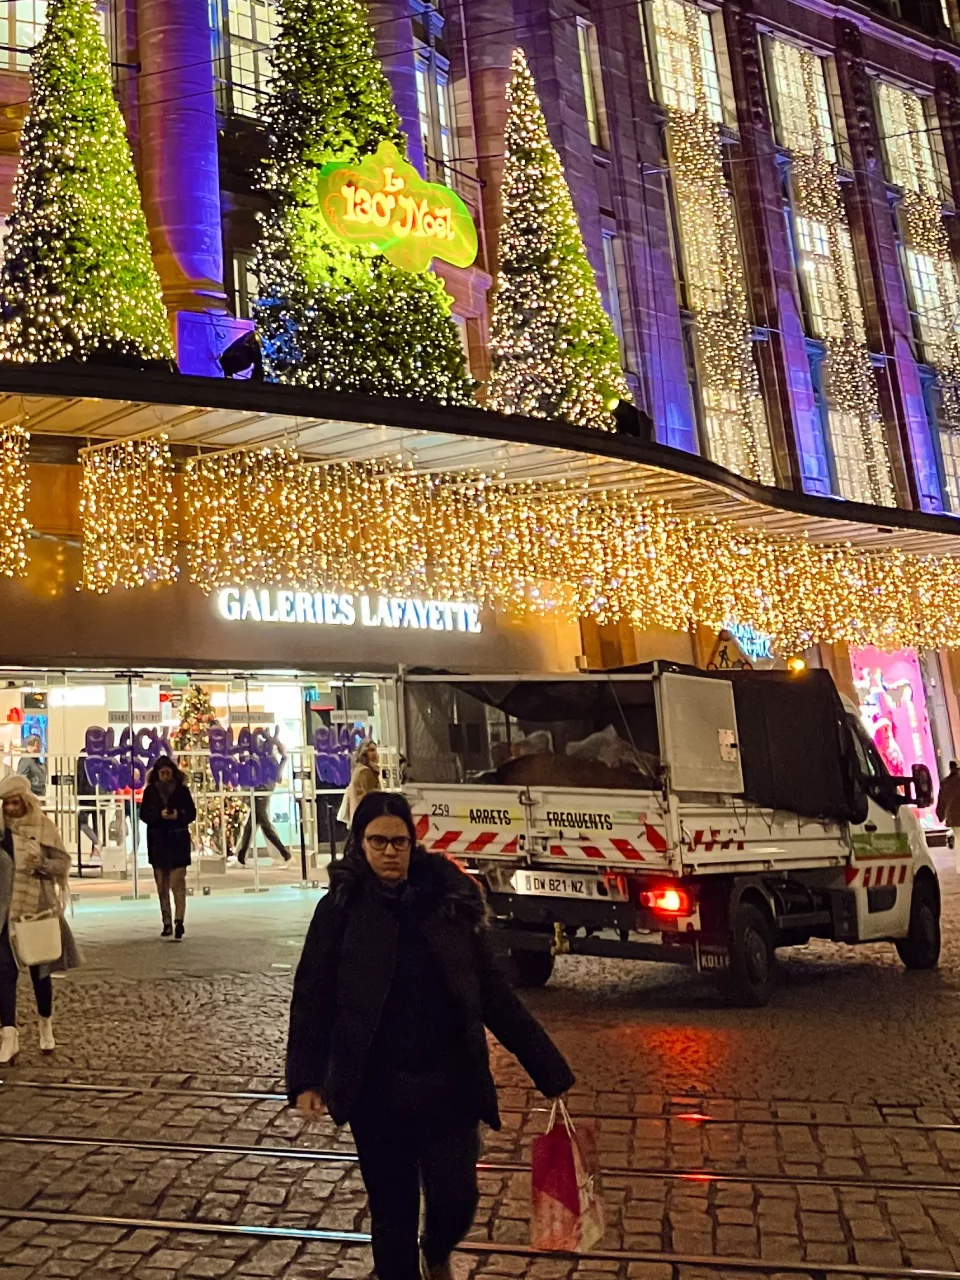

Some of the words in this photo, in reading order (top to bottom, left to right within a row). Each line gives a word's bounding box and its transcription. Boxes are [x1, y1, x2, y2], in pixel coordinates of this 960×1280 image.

[217, 587, 355, 626] GALERIES
[360, 594, 482, 634] LAFAYETTE
[84, 725, 174, 766] BLACK
[209, 723, 286, 758] BLACK
[431, 803, 450, 817] 259
[468, 808, 512, 826] ARRETS
[546, 811, 613, 831] FREQUENTS
